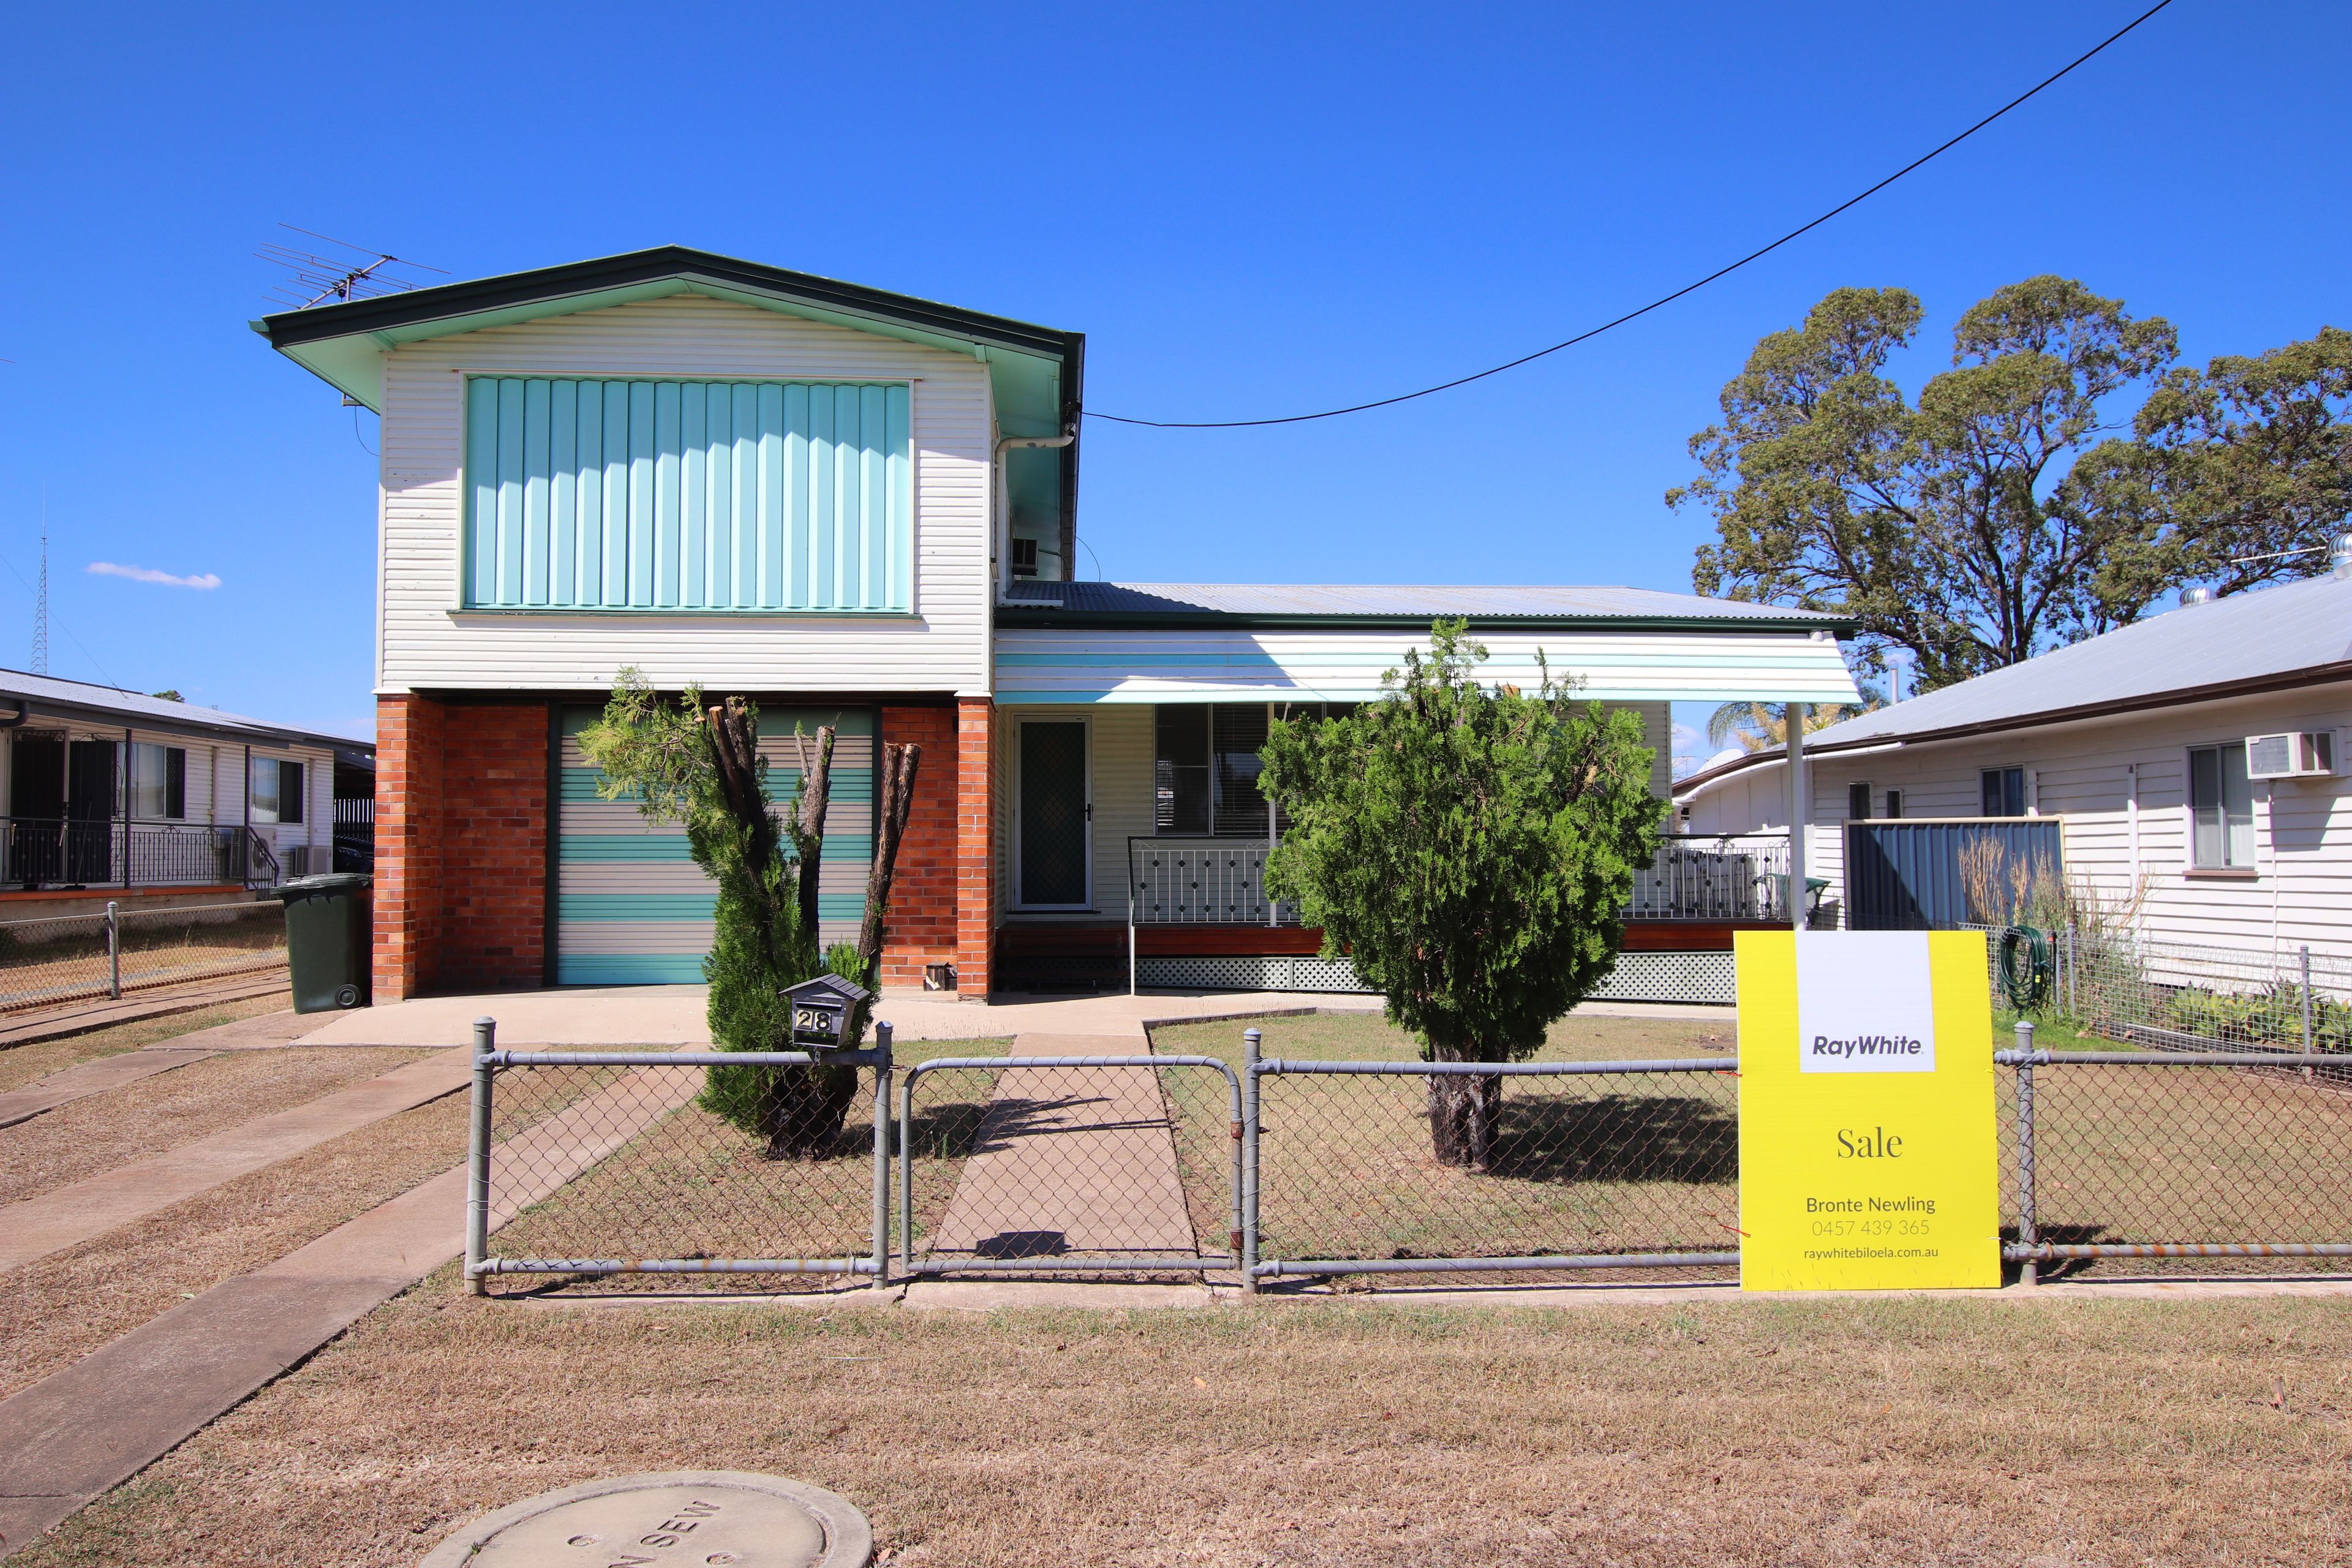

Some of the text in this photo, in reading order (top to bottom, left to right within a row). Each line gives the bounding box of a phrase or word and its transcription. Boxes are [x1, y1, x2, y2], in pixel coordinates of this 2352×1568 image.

[797, 1011, 830, 1030] 28
[1812, 1036, 1921, 1059] RayWhite
[1838, 1126, 1903, 1158] Sale
[1806, 1196, 1936, 1215] Bronte Newling
[1812, 1219, 1930, 1236] 0457 439 365
[1804, 1246, 1939, 1261] raywhitebiloela.com.au
[639, 1500, 722, 1548] SEW
